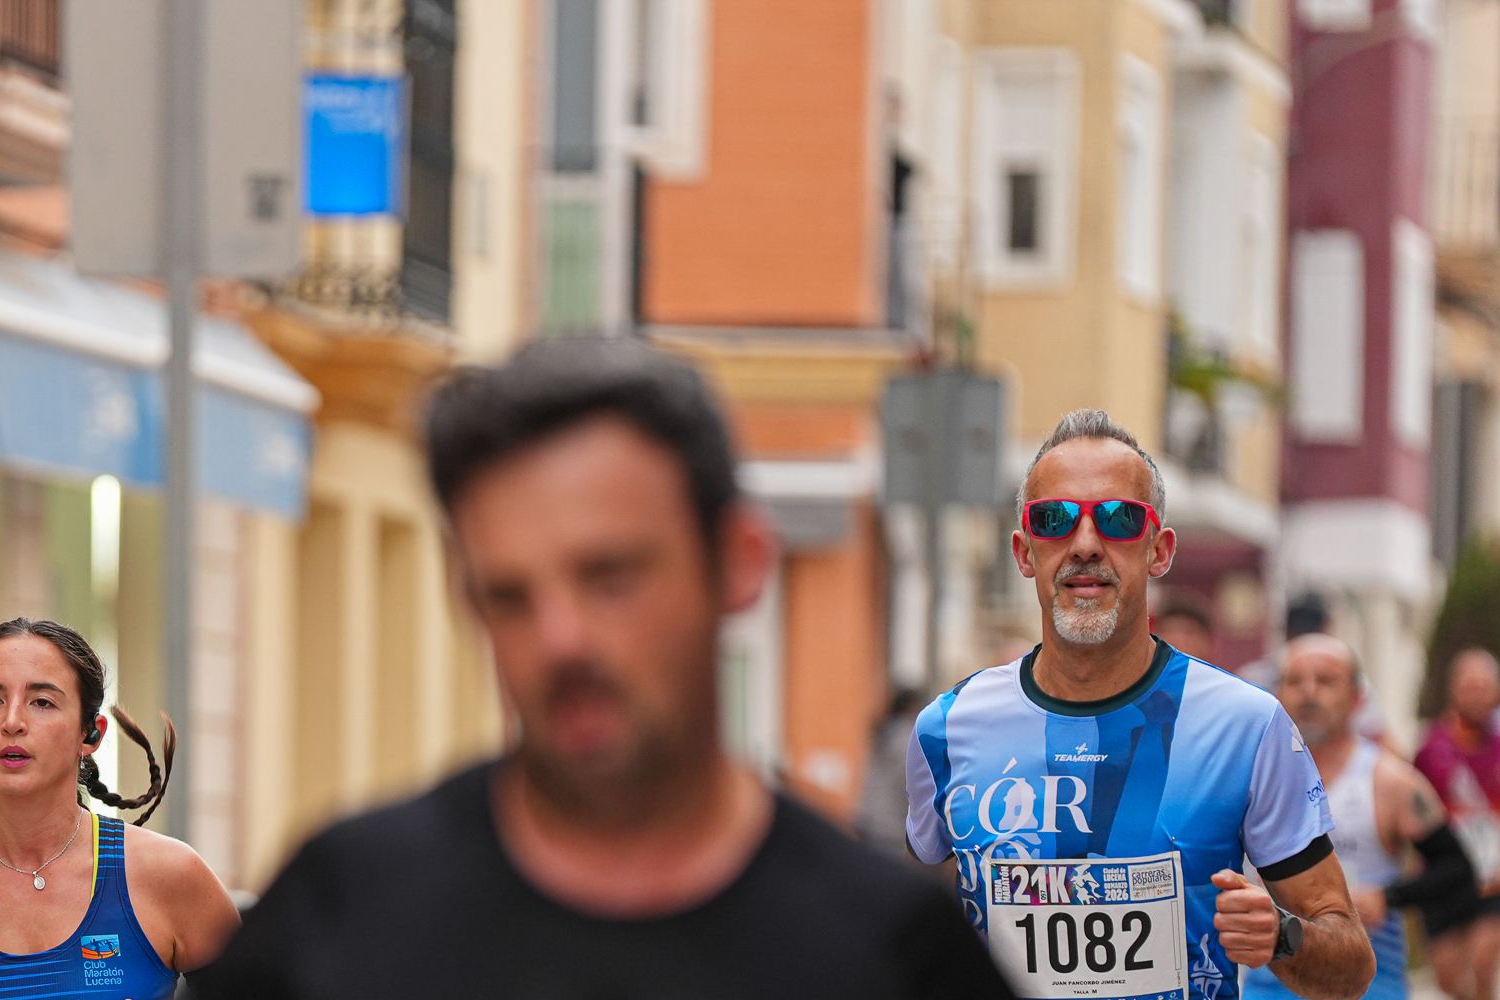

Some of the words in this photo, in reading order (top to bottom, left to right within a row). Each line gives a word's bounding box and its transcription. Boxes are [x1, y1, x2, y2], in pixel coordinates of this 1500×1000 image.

[1054, 754, 1108, 762] TEAMERGY
[944, 757, 1093, 841] CÓR
[1104, 873, 1126, 881] LUCENA
[1132, 868, 1165, 878] carreras
[1000, 865, 1011, 903] MARATÓN
[1011, 866, 1071, 904] 21K
[1132, 873, 1172, 886] populares
[994, 879, 1002, 903] MEDIA
[1105, 889, 1129, 901] 2026
[1015, 910, 1154, 974] 1082
[83, 961, 106, 969] Club
[84, 967, 124, 978] Maratón
[85, 976, 122, 986] Lucena
